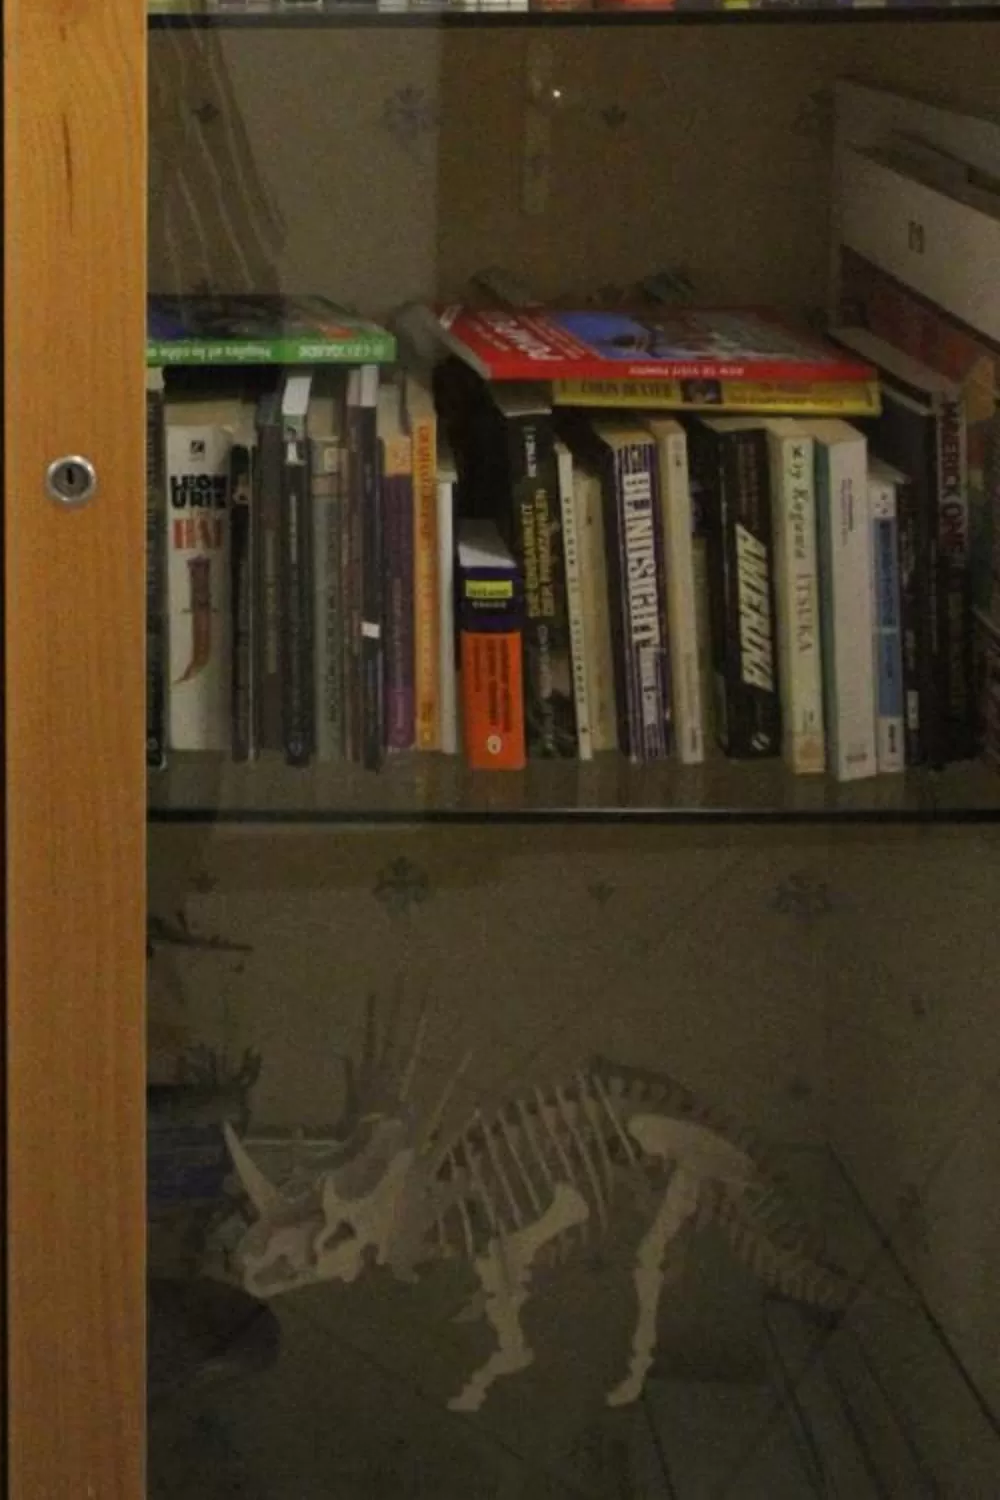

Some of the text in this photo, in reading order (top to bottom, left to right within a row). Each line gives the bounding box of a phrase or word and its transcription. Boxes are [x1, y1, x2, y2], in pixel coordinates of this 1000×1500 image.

[939, 400, 964, 499] MAVERICK
[735, 523, 774, 693] AMERIKA
[795, 572, 814, 654] ITSUKA
